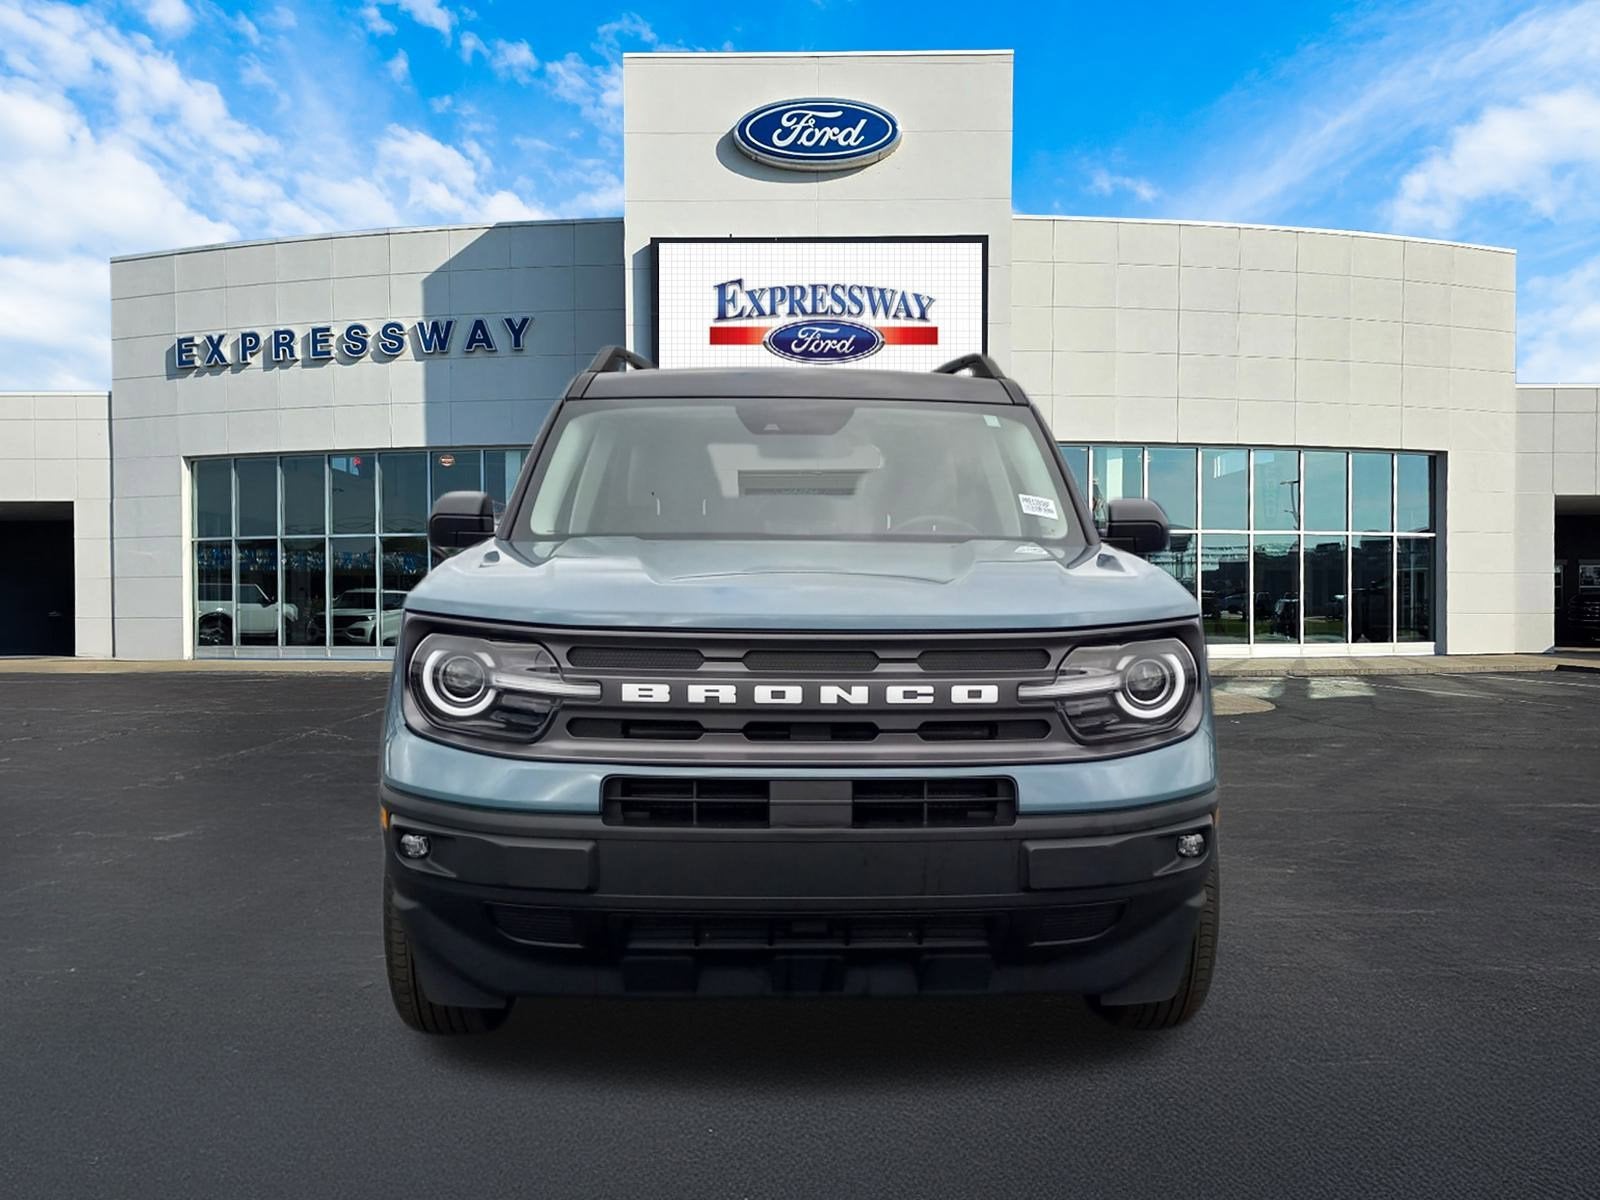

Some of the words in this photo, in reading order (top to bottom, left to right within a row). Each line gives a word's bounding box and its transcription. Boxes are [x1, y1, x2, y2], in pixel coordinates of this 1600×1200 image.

[772, 109, 867, 147] Ford
[175, 315, 532, 369] EXPRESSWAY
[790, 326, 855, 354] Ford
[621, 683, 999, 704] BRONCO
